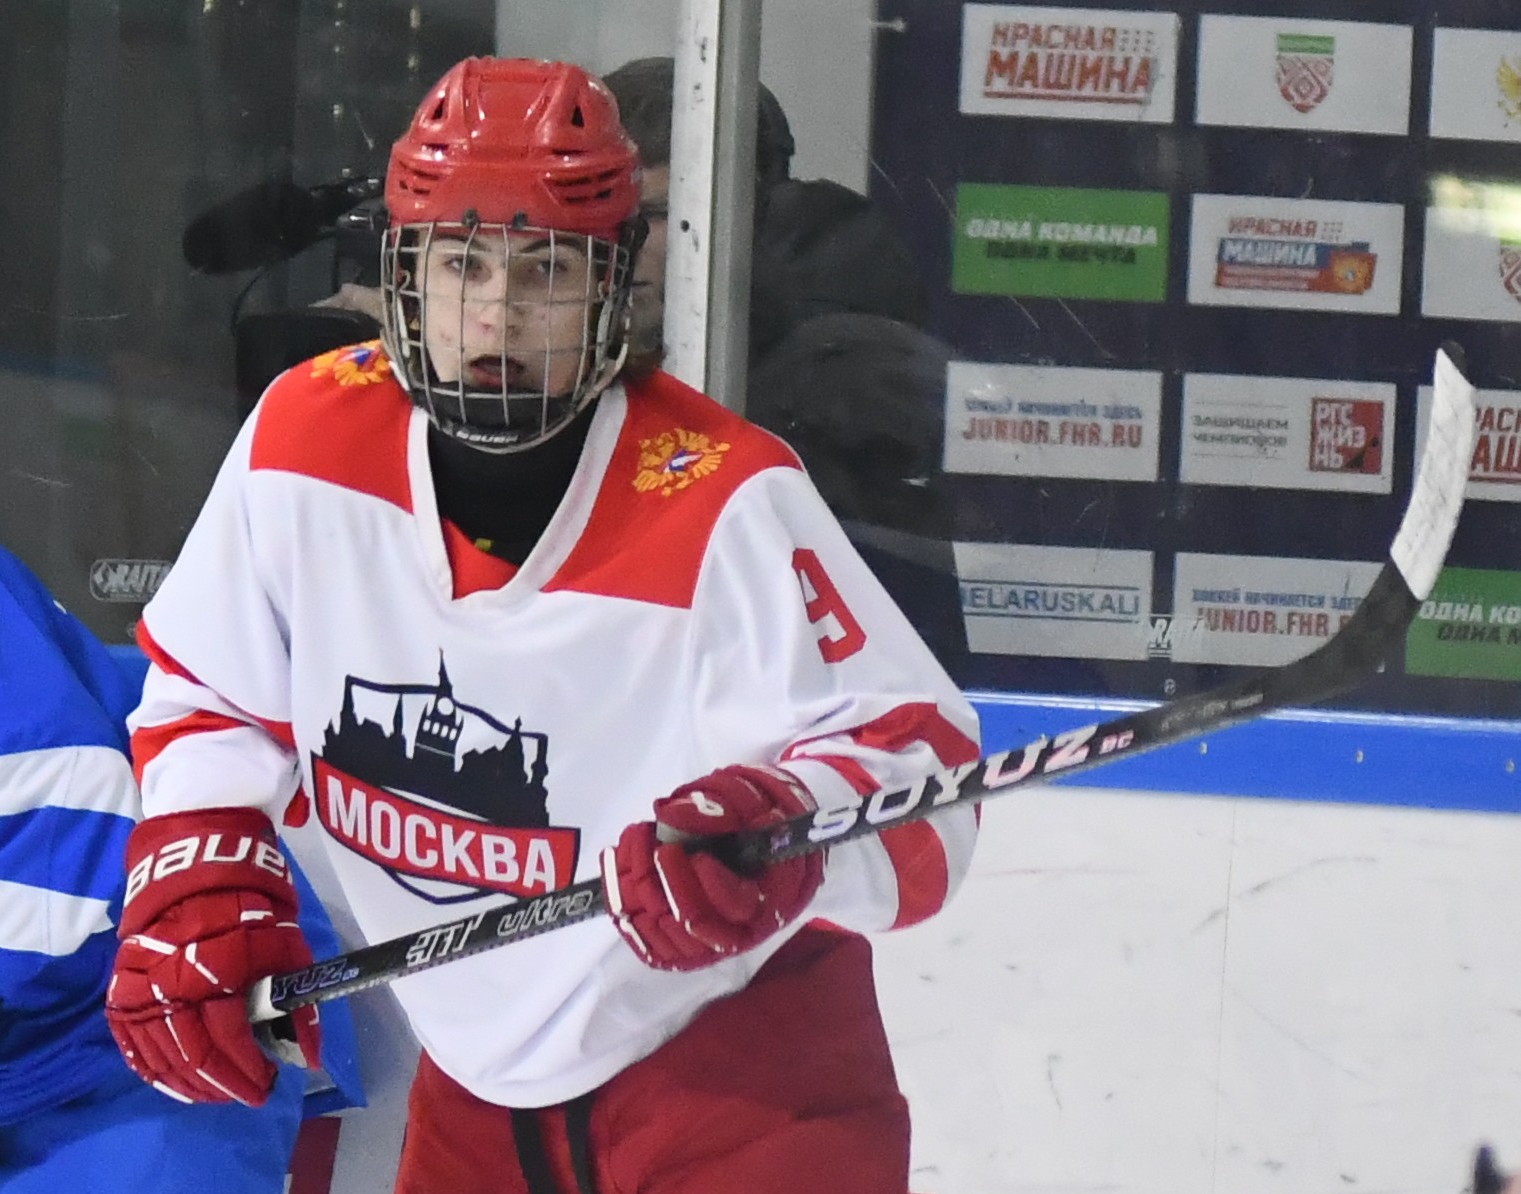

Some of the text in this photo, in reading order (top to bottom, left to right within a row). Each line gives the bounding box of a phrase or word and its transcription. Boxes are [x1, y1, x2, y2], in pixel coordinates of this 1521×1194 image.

[992, 22, 1116, 50] КРАСНАЯ
[984, 50, 1151, 94] МАШИНА
[963, 417, 1143, 449] JUNIOR.FHR.RU
[790, 546, 868, 665] 9
[1418, 600, 1484, 622] ОДНА
[807, 722, 1099, 843] SOYUZ
[326, 774, 556, 894] МОСКВА
[123, 833, 293, 908] BAUE
